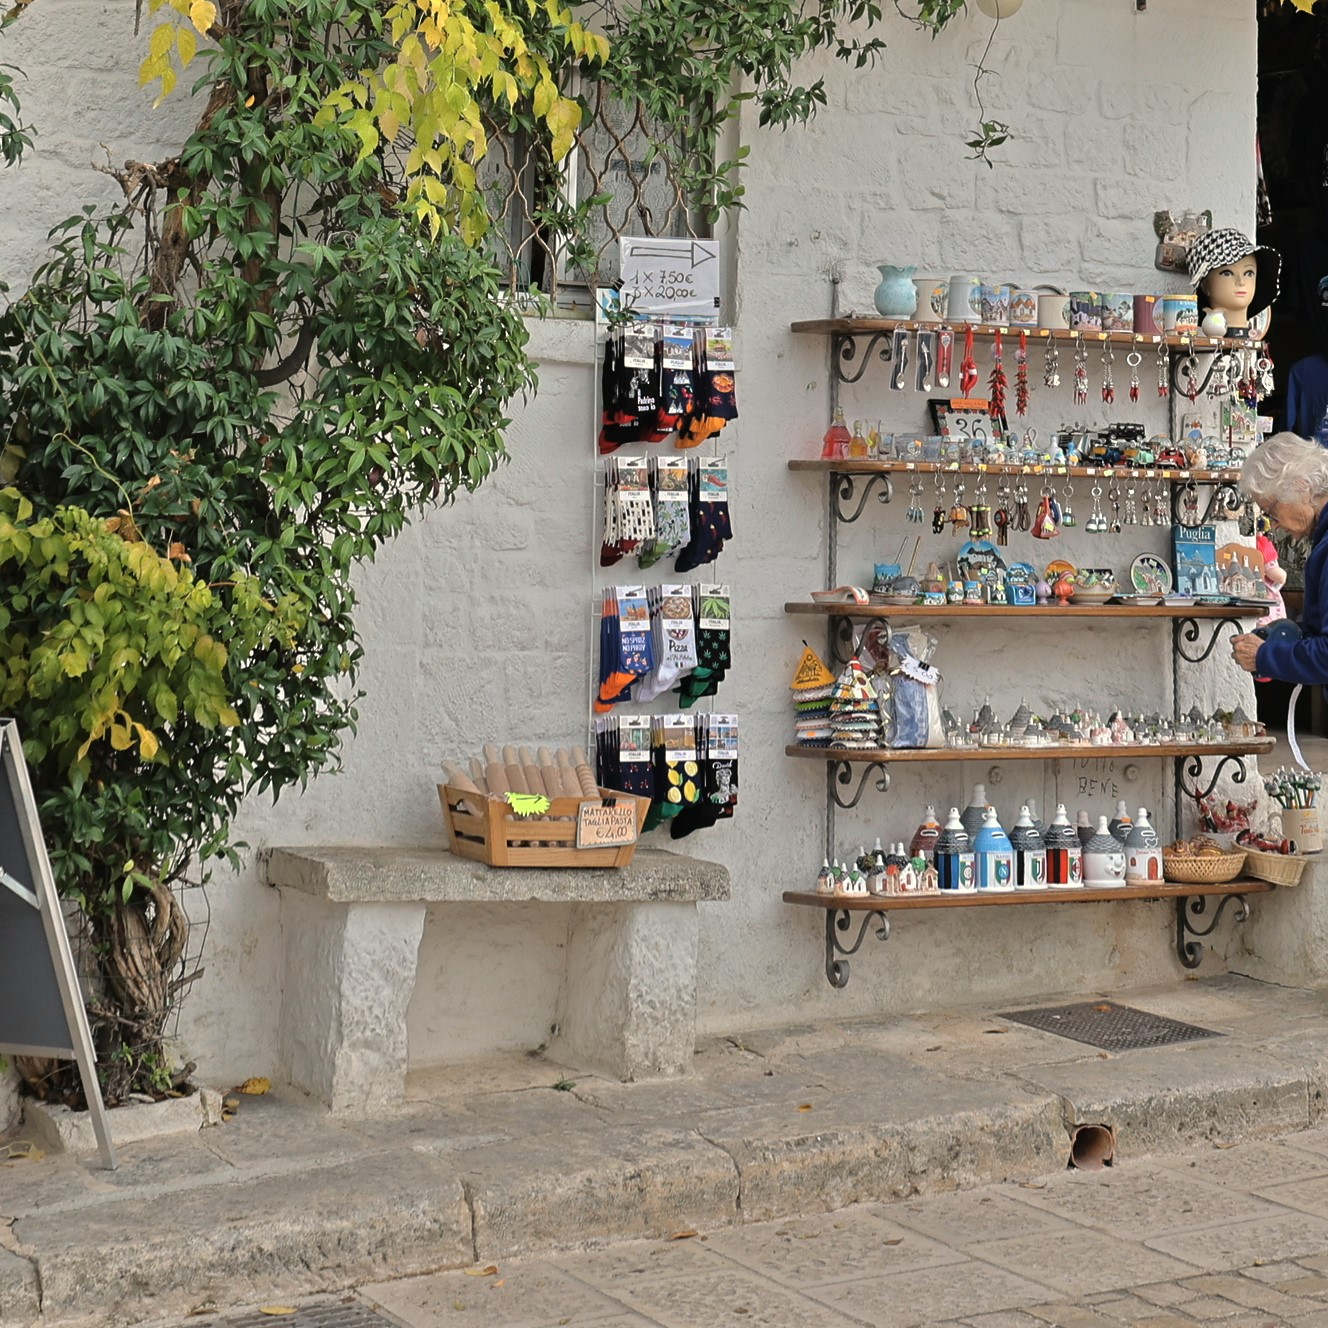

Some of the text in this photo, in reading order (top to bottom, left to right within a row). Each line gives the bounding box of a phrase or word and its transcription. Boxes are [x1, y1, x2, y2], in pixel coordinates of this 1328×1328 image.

[629, 268, 639, 285] 1
[1179, 526, 1211, 542] Puglia
[668, 639, 689, 653] Pizza
[1078, 775, 1119, 799] BENE
